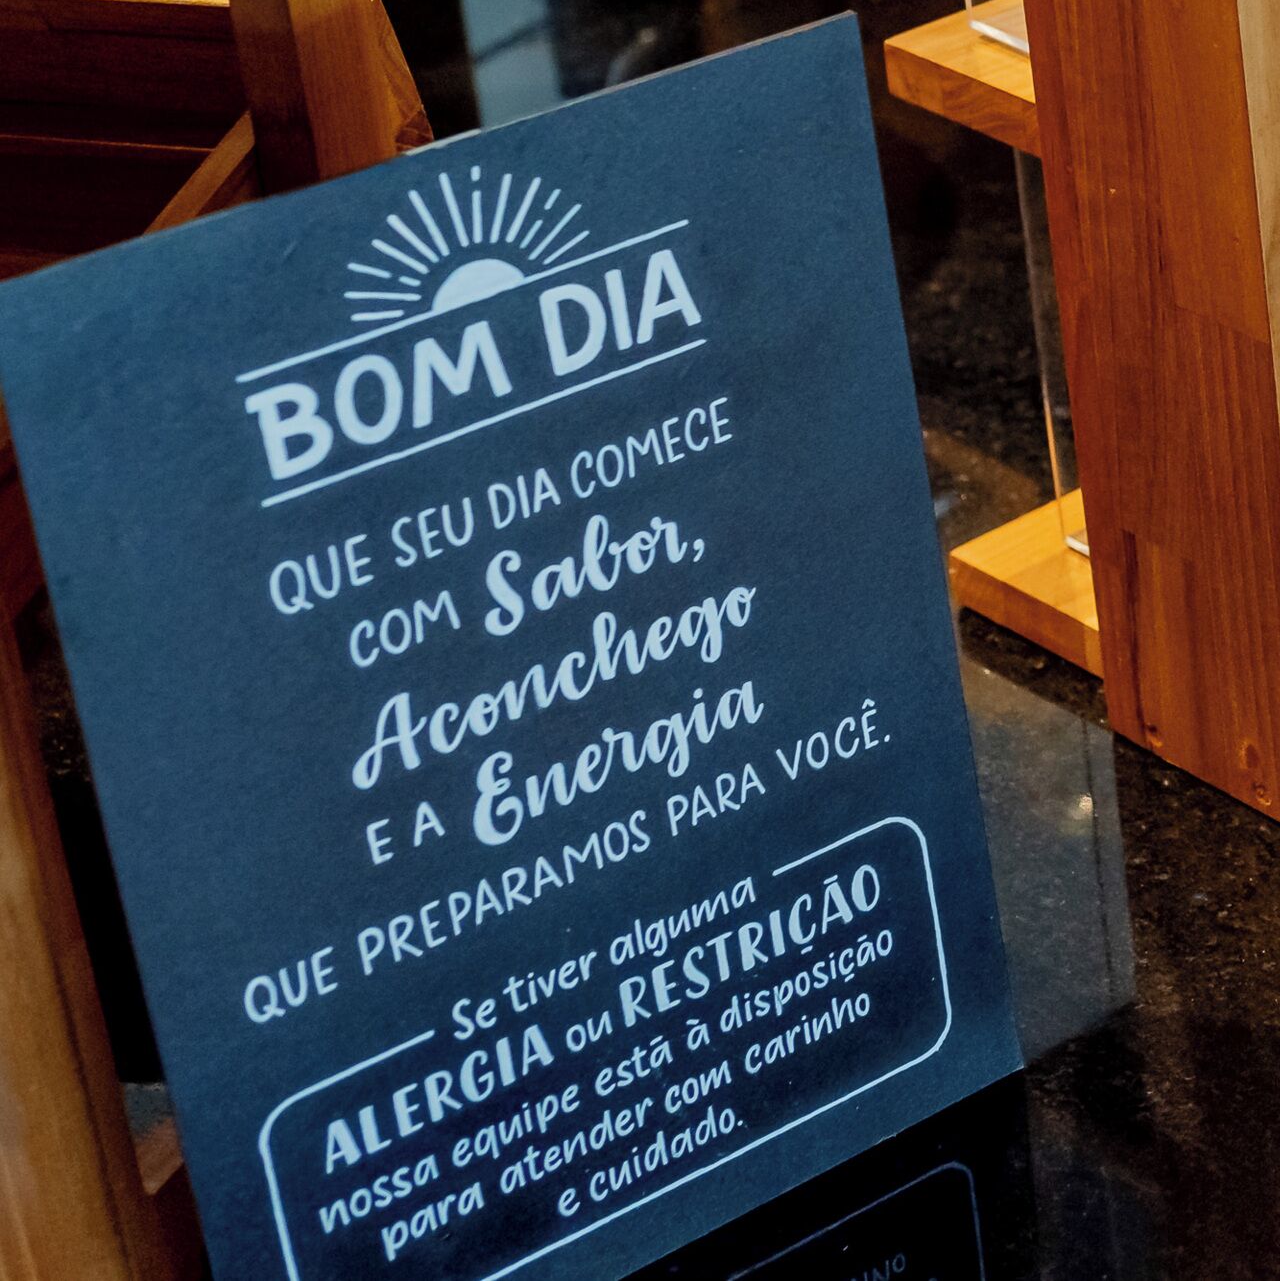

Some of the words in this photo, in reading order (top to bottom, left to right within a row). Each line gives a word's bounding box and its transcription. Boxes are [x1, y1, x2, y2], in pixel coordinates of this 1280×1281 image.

[245, 320, 513, 480] BOM
[540, 249, 702, 377] DIA
[269, 534, 374, 615] QUE
[391, 496, 475, 567] SEU
[488, 467, 562, 530] DIA
[570, 397, 733, 499] COMECE
[349, 590, 460, 668] COM
[484, 514, 705, 636] Sabor,
[351, 586, 757, 790] Aconchego
[365, 818, 395, 865] E
[412, 801, 446, 847] A
[472, 681, 765, 846] Energia
[243, 946, 338, 1024] QUE
[357, 809, 651, 975] PREPARAMOS
[666, 762, 766, 837] PARA
[775, 698, 891, 781] VOCÊ.
[452, 998, 497, 1041] Se
[502, 950, 597, 1013] tiver
[609, 876, 756, 966] alguma
[318, 1154, 439, 1234] nossa
[452, 1084, 580, 1168] equipe
[719, 929, 893, 1033] disposição
[325, 1024, 554, 1174] ALERGIA
[565, 1010, 613, 1052] ou
[619, 864, 881, 1027] RESTRIÇÃO
[380, 1181, 485, 1262] para
[500, 1096, 653, 1195] atender
[664, 1060, 732, 1114] com
[744, 992, 871, 1074] carinho
[556, 1186, 580, 1217] e
[589, 1106, 744, 1202] cuidado.
